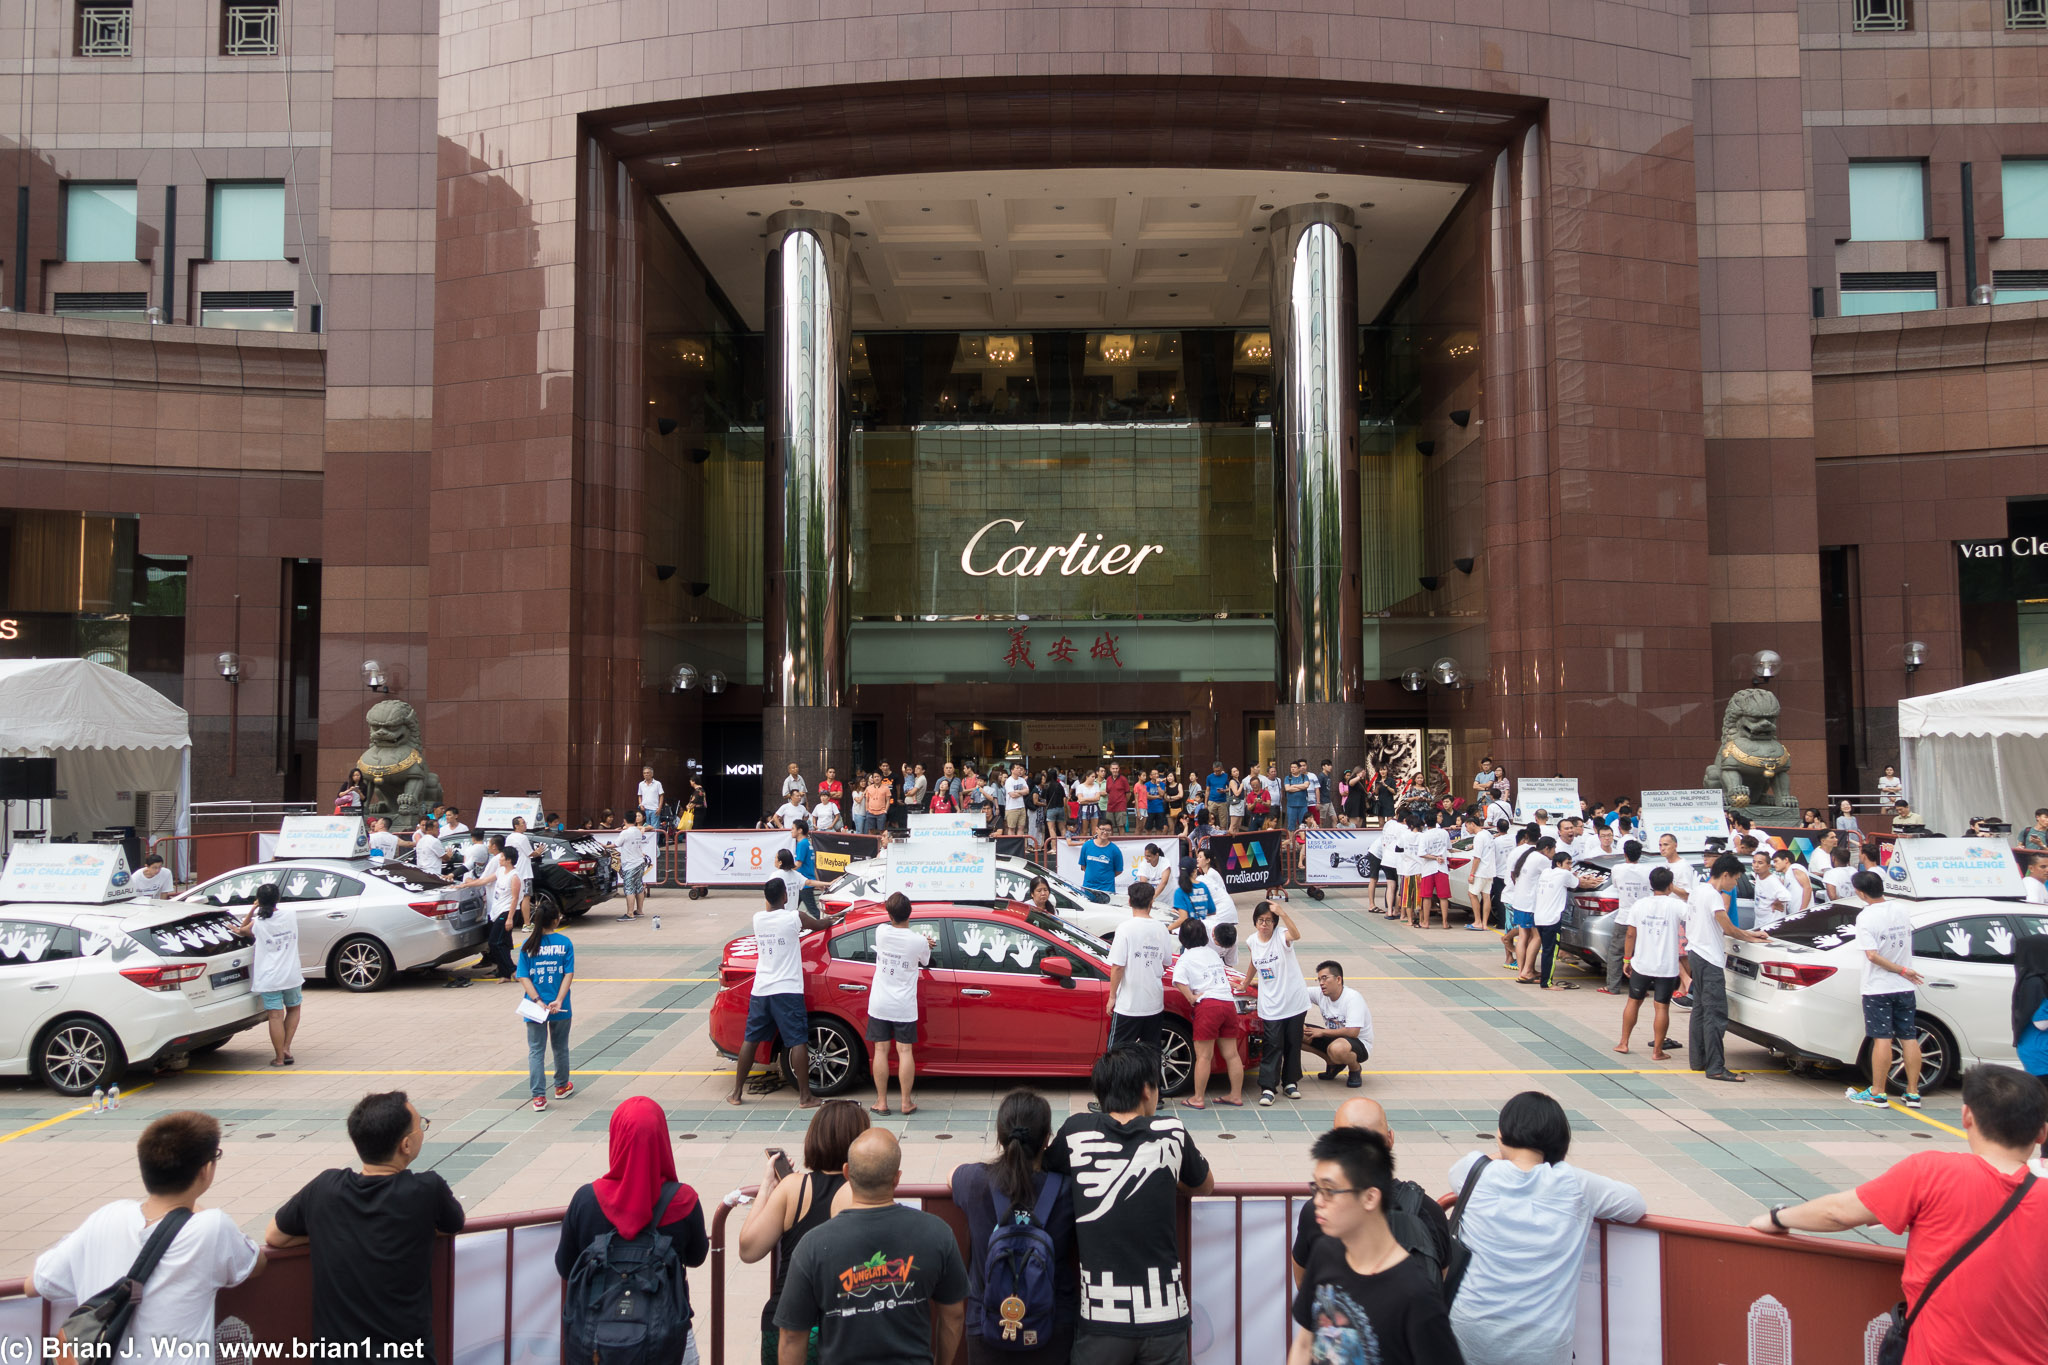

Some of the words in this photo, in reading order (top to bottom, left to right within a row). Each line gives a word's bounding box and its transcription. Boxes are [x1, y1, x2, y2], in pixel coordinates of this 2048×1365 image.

[961, 518, 1164, 576] Cartier
[725, 764, 764, 775] MONT
[750, 846, 763, 867] 8
[824, 857, 848, 867] Maybank
[1894, 851, 1900, 864] 3
[118, 858, 124, 870] 9
[896, 865, 918, 874] CAR
[921, 865, 984, 873] CHALLENGE
[1917, 861, 1939, 870] CAR
[1942, 861, 2006, 869] CHALLENGE
[13, 867, 36, 876] CAR
[38, 867, 102, 876] CHALLENGE
[1225, 870, 1270, 884] mediacorp
[107, 887, 134, 898] SUBARU
[1885, 882, 1912, 893] SUBARU
